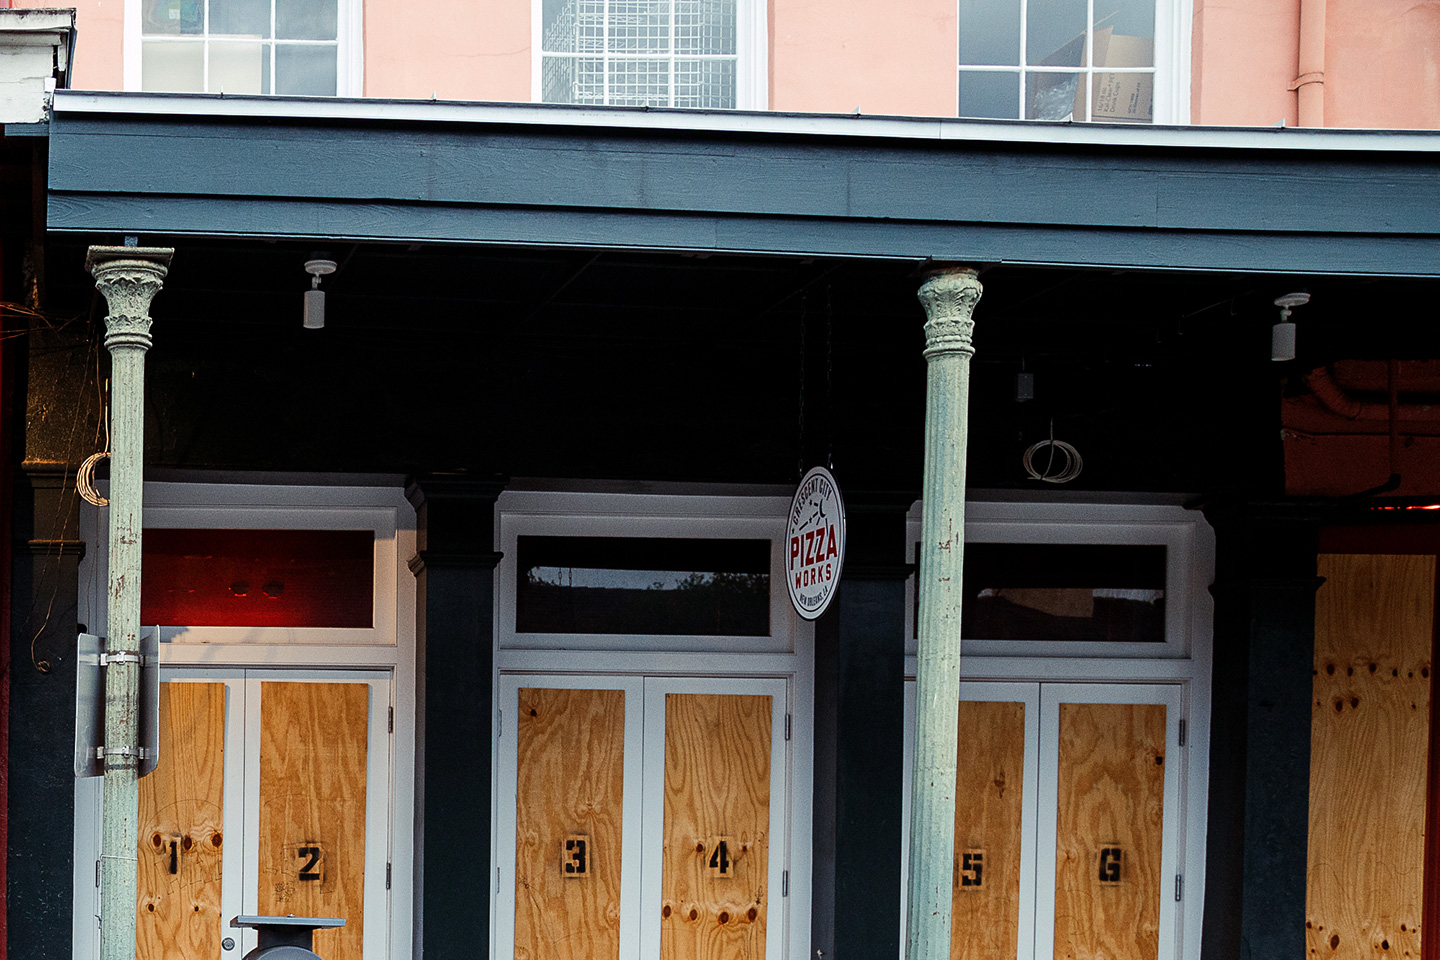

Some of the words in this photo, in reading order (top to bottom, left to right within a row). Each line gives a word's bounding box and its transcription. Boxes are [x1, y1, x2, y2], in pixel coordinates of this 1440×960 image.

[1109, 96, 1117, 113] Drink
[1113, 81, 1121, 97] Cups
[792, 478, 819, 526] CRESCENT
[819, 478, 832, 501] CITY
[790, 523, 838, 571] PIZZA
[795, 562, 832, 590] WORKS
[799, 592, 808, 607] NEW
[823, 585, 829, 597] LA
[169, 841, 178, 875] 1
[298, 847, 321, 881] 2
[565, 840, 587, 874] 3
[708, 840, 730, 874] 4
[962, 853, 983, 886] 5
